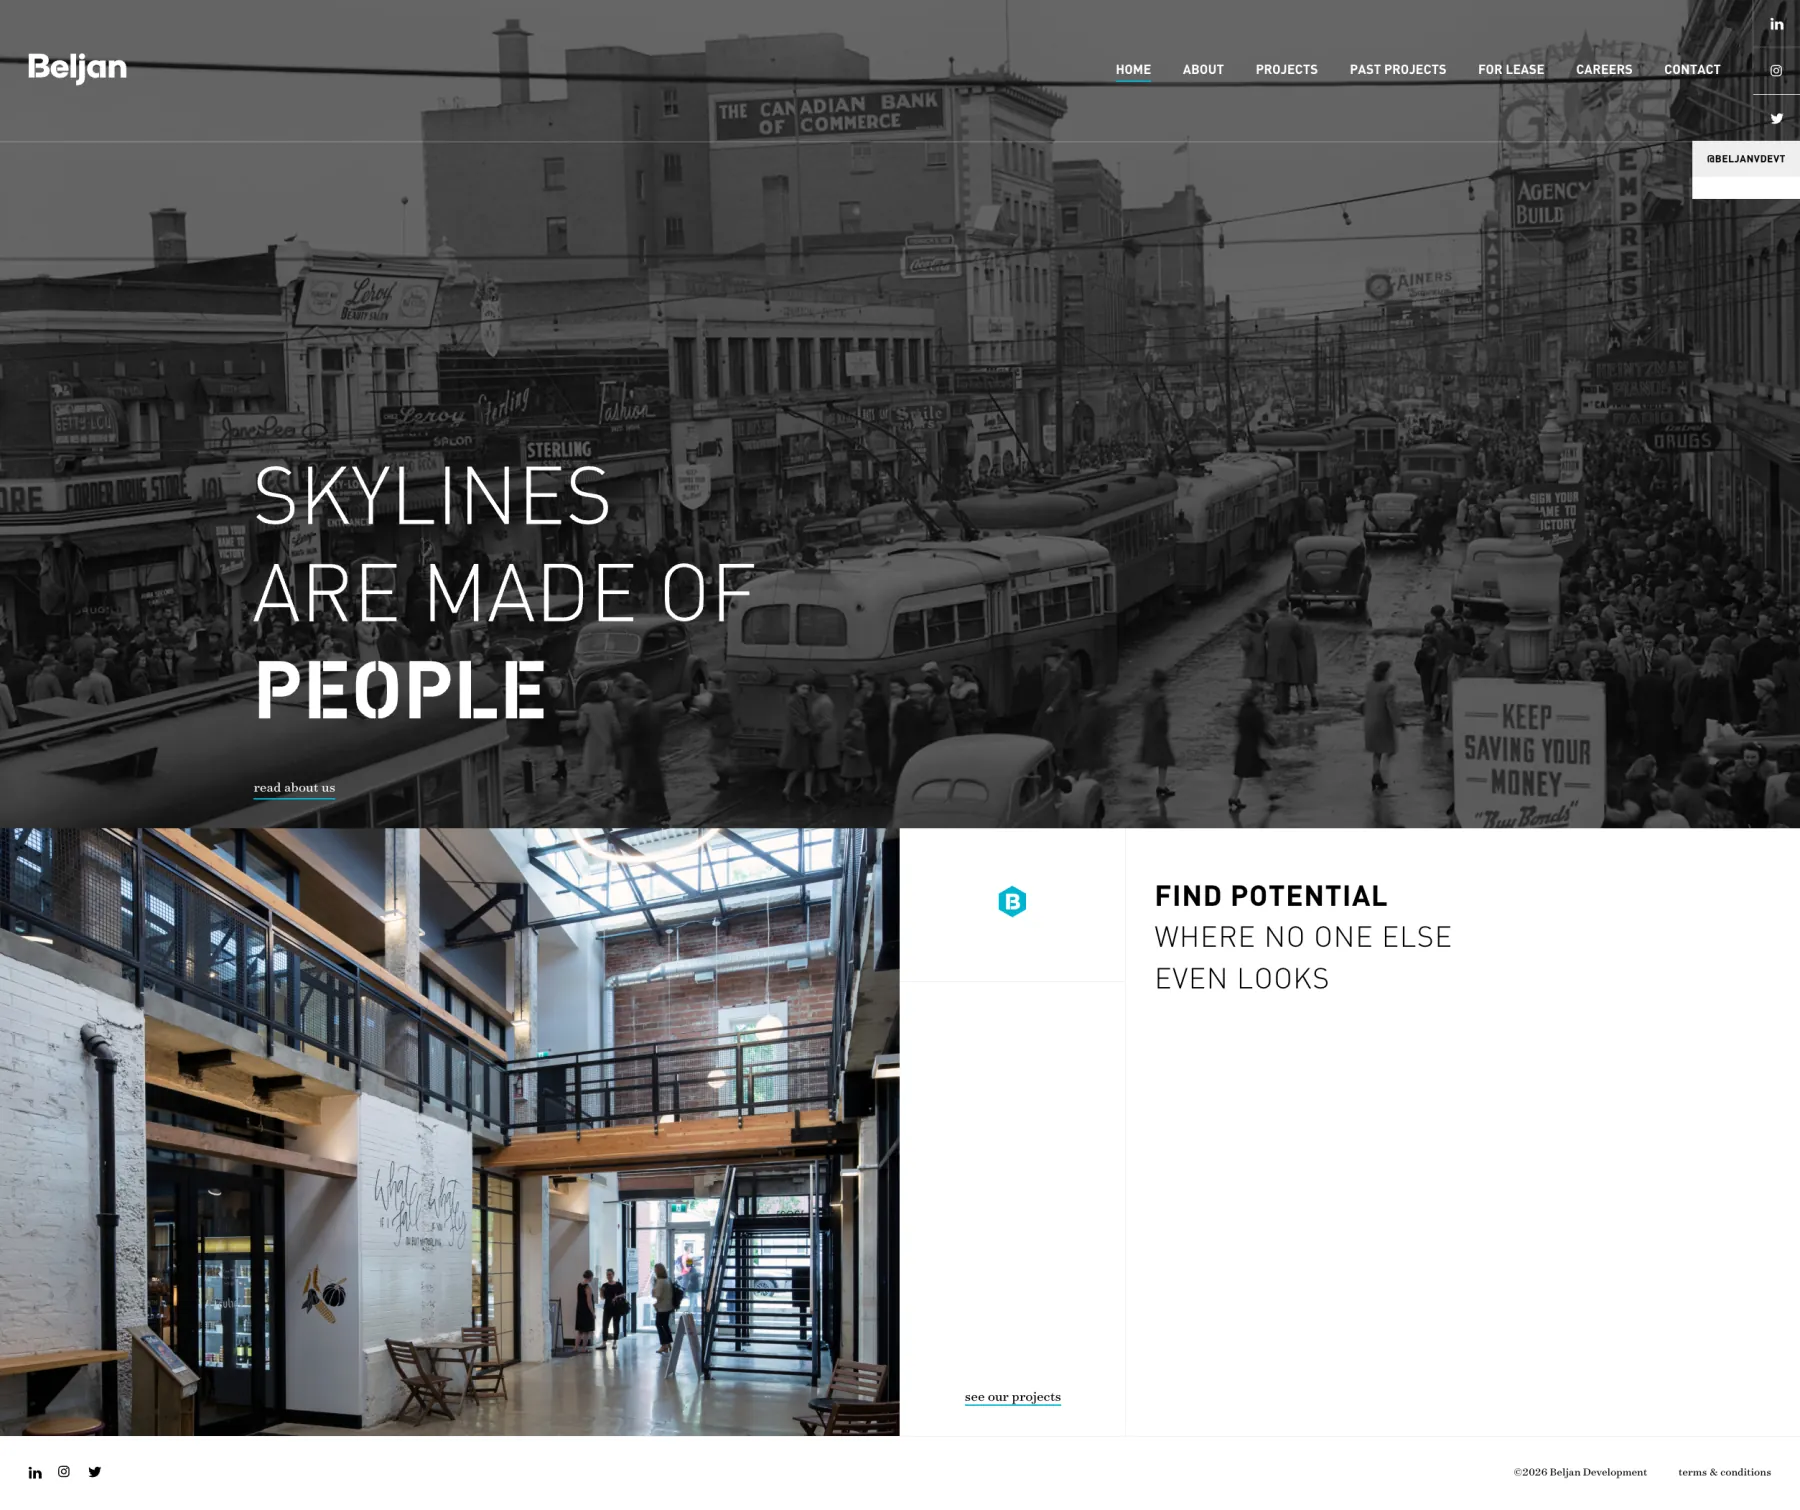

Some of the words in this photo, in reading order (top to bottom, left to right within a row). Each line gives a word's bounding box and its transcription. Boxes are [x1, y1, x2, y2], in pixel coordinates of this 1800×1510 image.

[719, 103, 748, 119] THE
[760, 97, 865, 117] CANADIAN
[881, 91, 938, 110] BANK
[759, 119, 785, 135] OF
[800, 113, 901, 133] COMMERCE
[1518, 181, 1591, 200] AGENCY
[1618, 148, 1638, 321] EMPRESS
[345, 277, 398, 311] Leroy
[478, 387, 529, 425] Sterling
[599, 380, 656, 425] Fashion
[396, 406, 466, 428] Leroy
[527, 441, 592, 458] STERLING
[1654, 433, 1712, 449] DRUGS
[66, 481, 113, 511] CORNER
[116, 478, 147, 505] DRUG
[151, 474, 192, 501] STORE
[1529, 492, 1552, 505] SIGN
[1555, 491, 1579, 503] YOUR
[1565, 504, 1577, 516] TO
[1541, 518, 1577, 531] ICTORY
[1502, 703, 1552, 730] KEEP
[1464, 735, 1534, 763] SAVING
[1542, 738, 1590, 765] YOUR
[1491, 768, 1562, 797] MONEY
